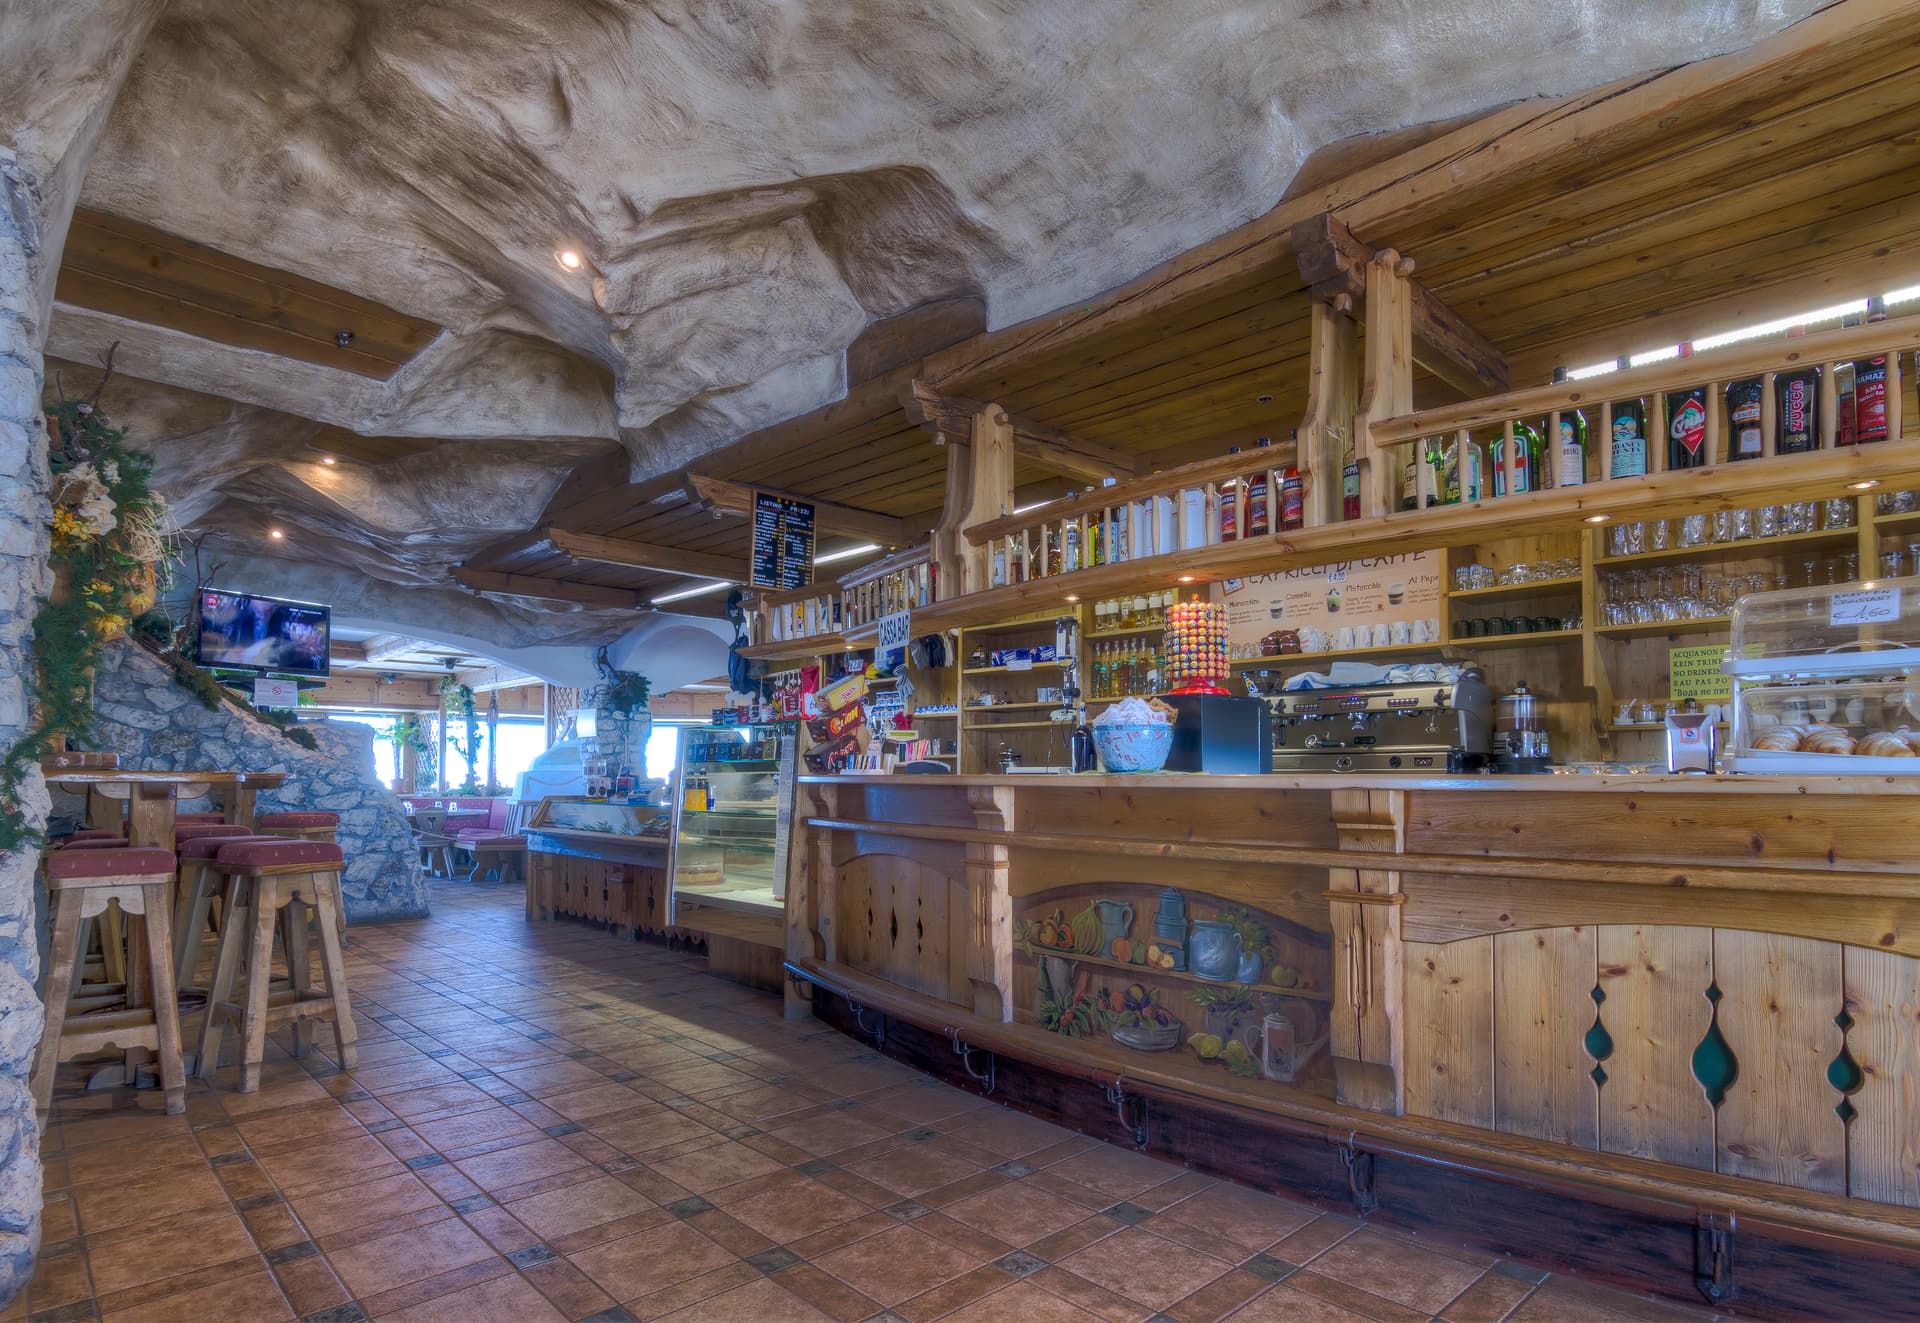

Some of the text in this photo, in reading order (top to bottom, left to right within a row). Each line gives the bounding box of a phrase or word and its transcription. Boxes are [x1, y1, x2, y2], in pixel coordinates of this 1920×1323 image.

[1790, 380, 1804, 432] ZUCCA
[880, 614, 909, 648] CASSA BAR
[1673, 650, 1699, 659] ACQUA
[1701, 649, 1719, 657] NON
[1673, 660, 1693, 668] KEIN
[1688, 668, 1720, 676] DRINKIN
